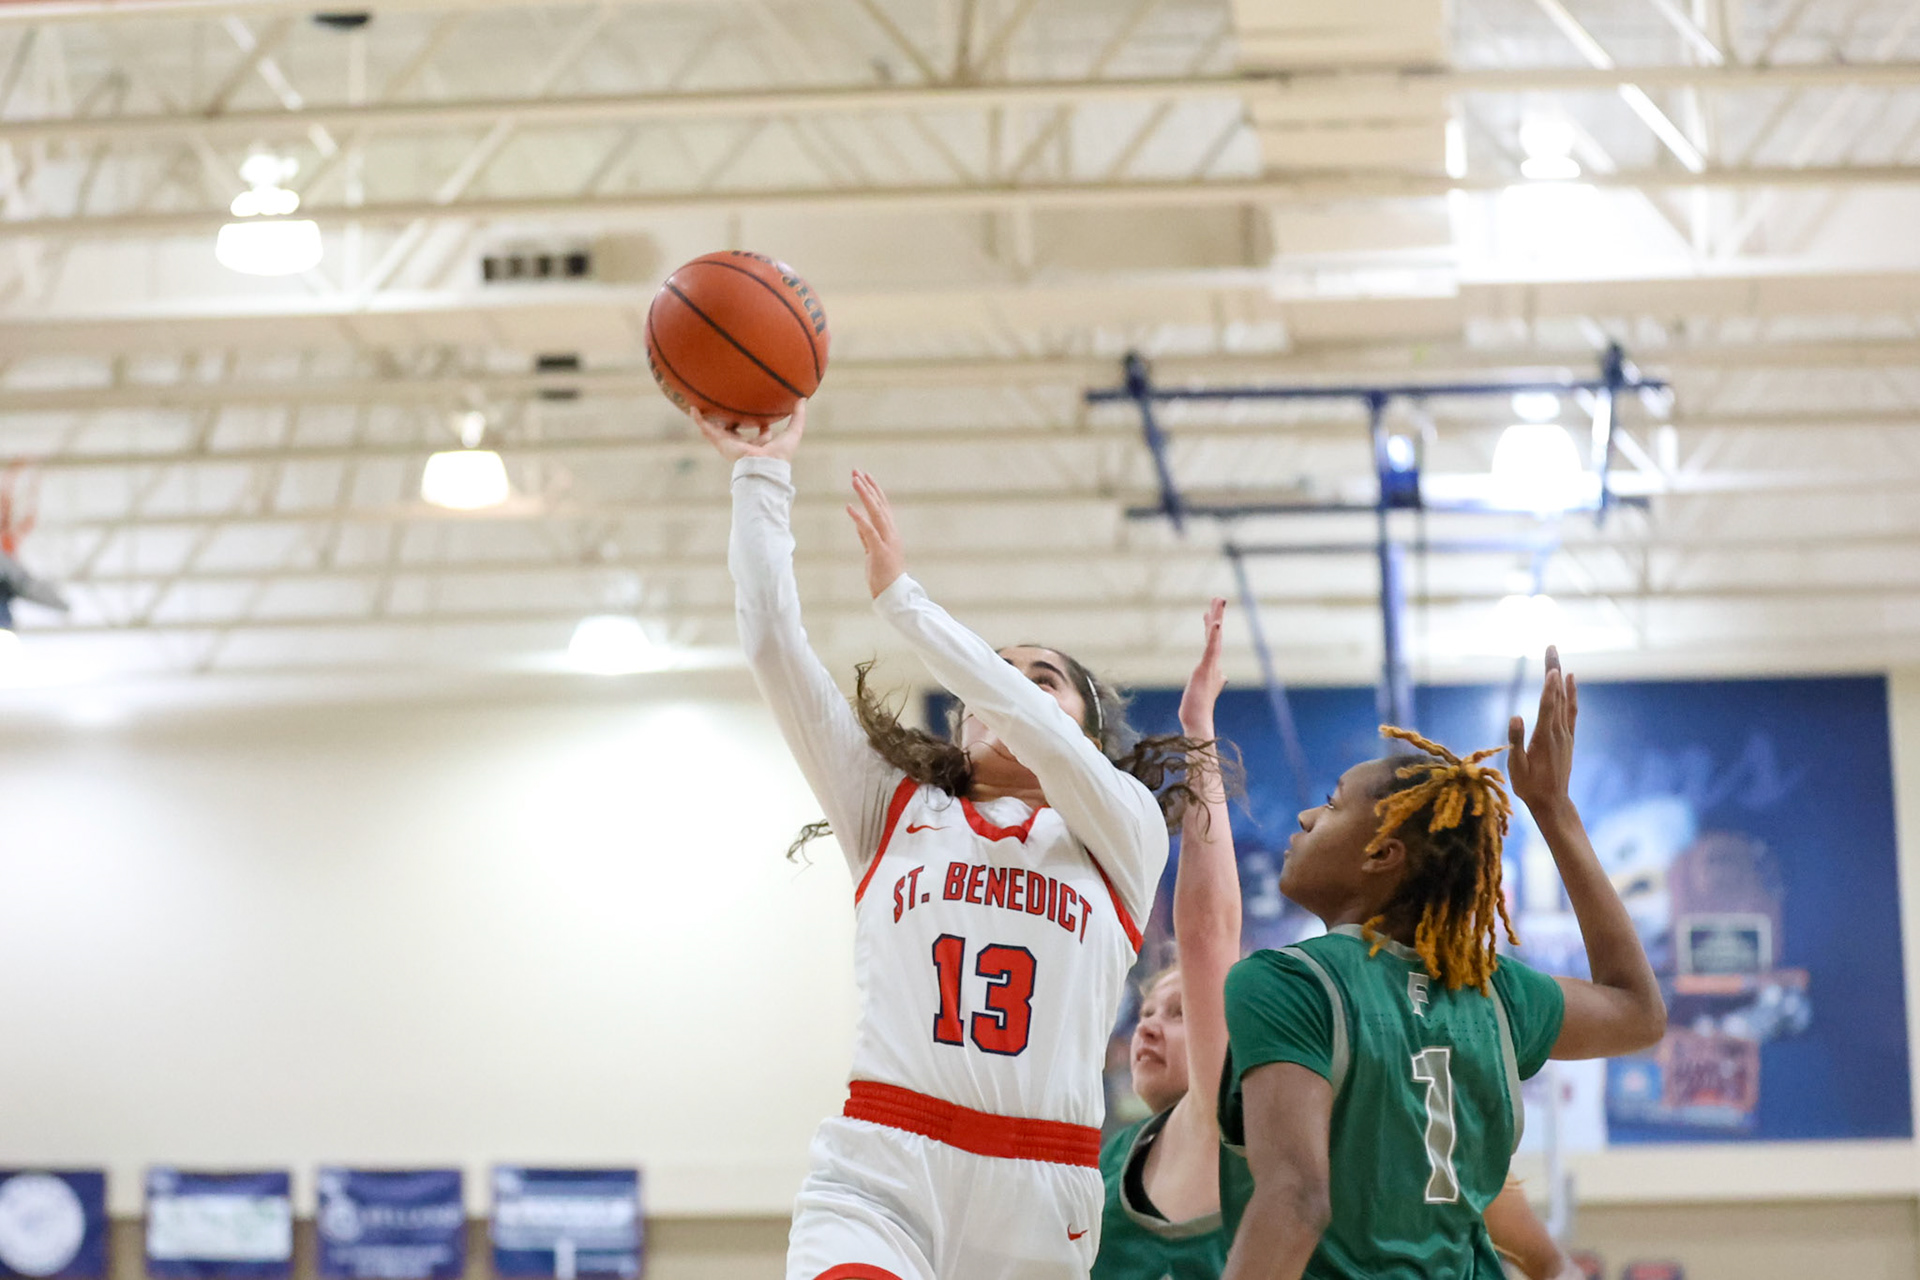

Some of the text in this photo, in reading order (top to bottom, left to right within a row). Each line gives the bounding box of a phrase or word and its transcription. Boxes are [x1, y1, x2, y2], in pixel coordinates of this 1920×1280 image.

[893, 862, 1092, 944] ST. BENEDICT
[932, 933, 1036, 1057] 13
[1407, 971, 1430, 1018] F
[1411, 1045, 1459, 1205] 1
